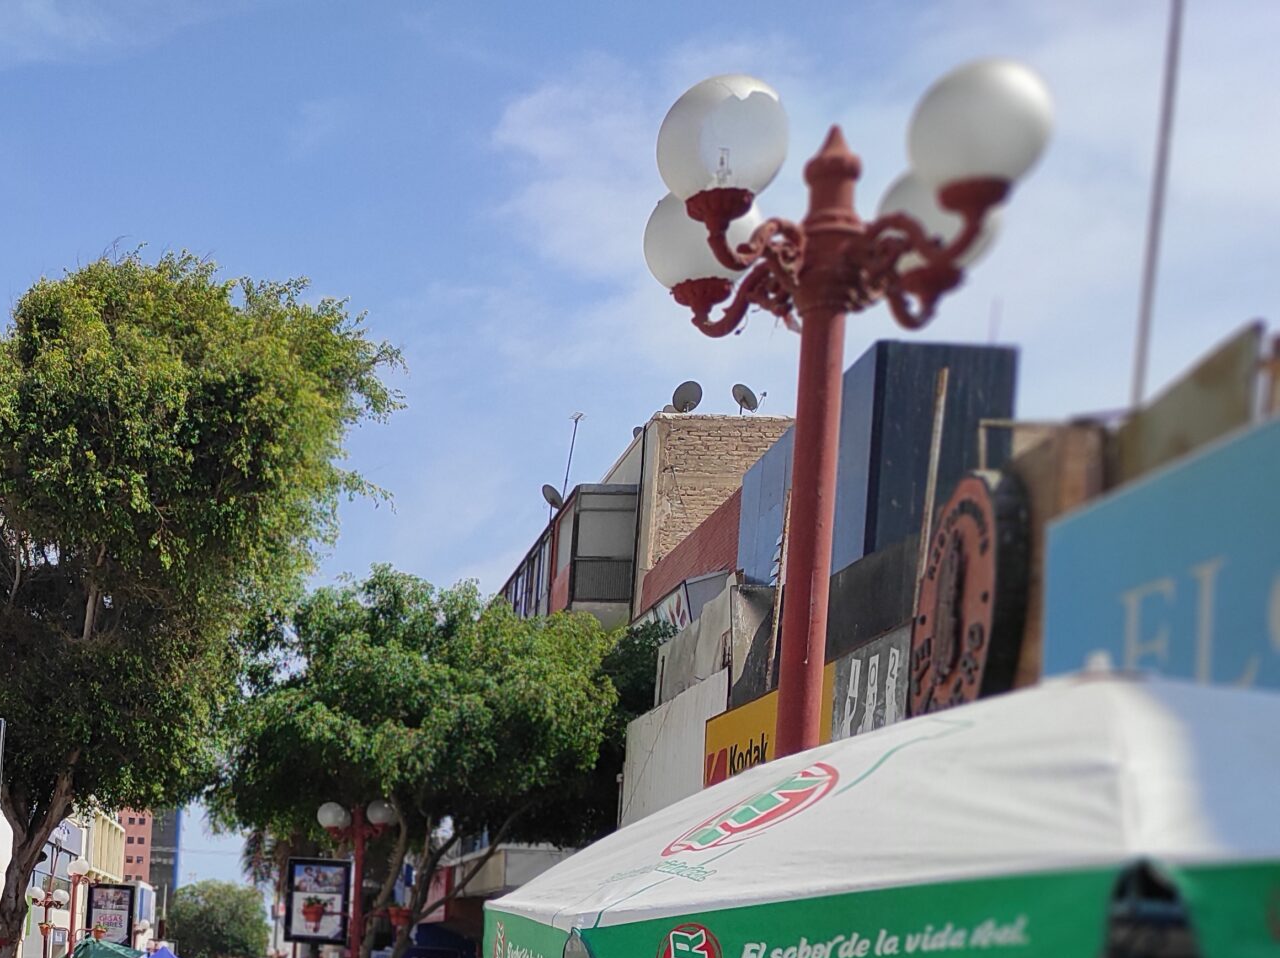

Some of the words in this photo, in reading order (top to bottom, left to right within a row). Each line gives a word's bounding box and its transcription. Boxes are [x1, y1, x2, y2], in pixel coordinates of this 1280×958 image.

[729, 732, 768, 776] Kodak
[874, 928, 900, 956] la
[905, 922, 968, 954] vida
